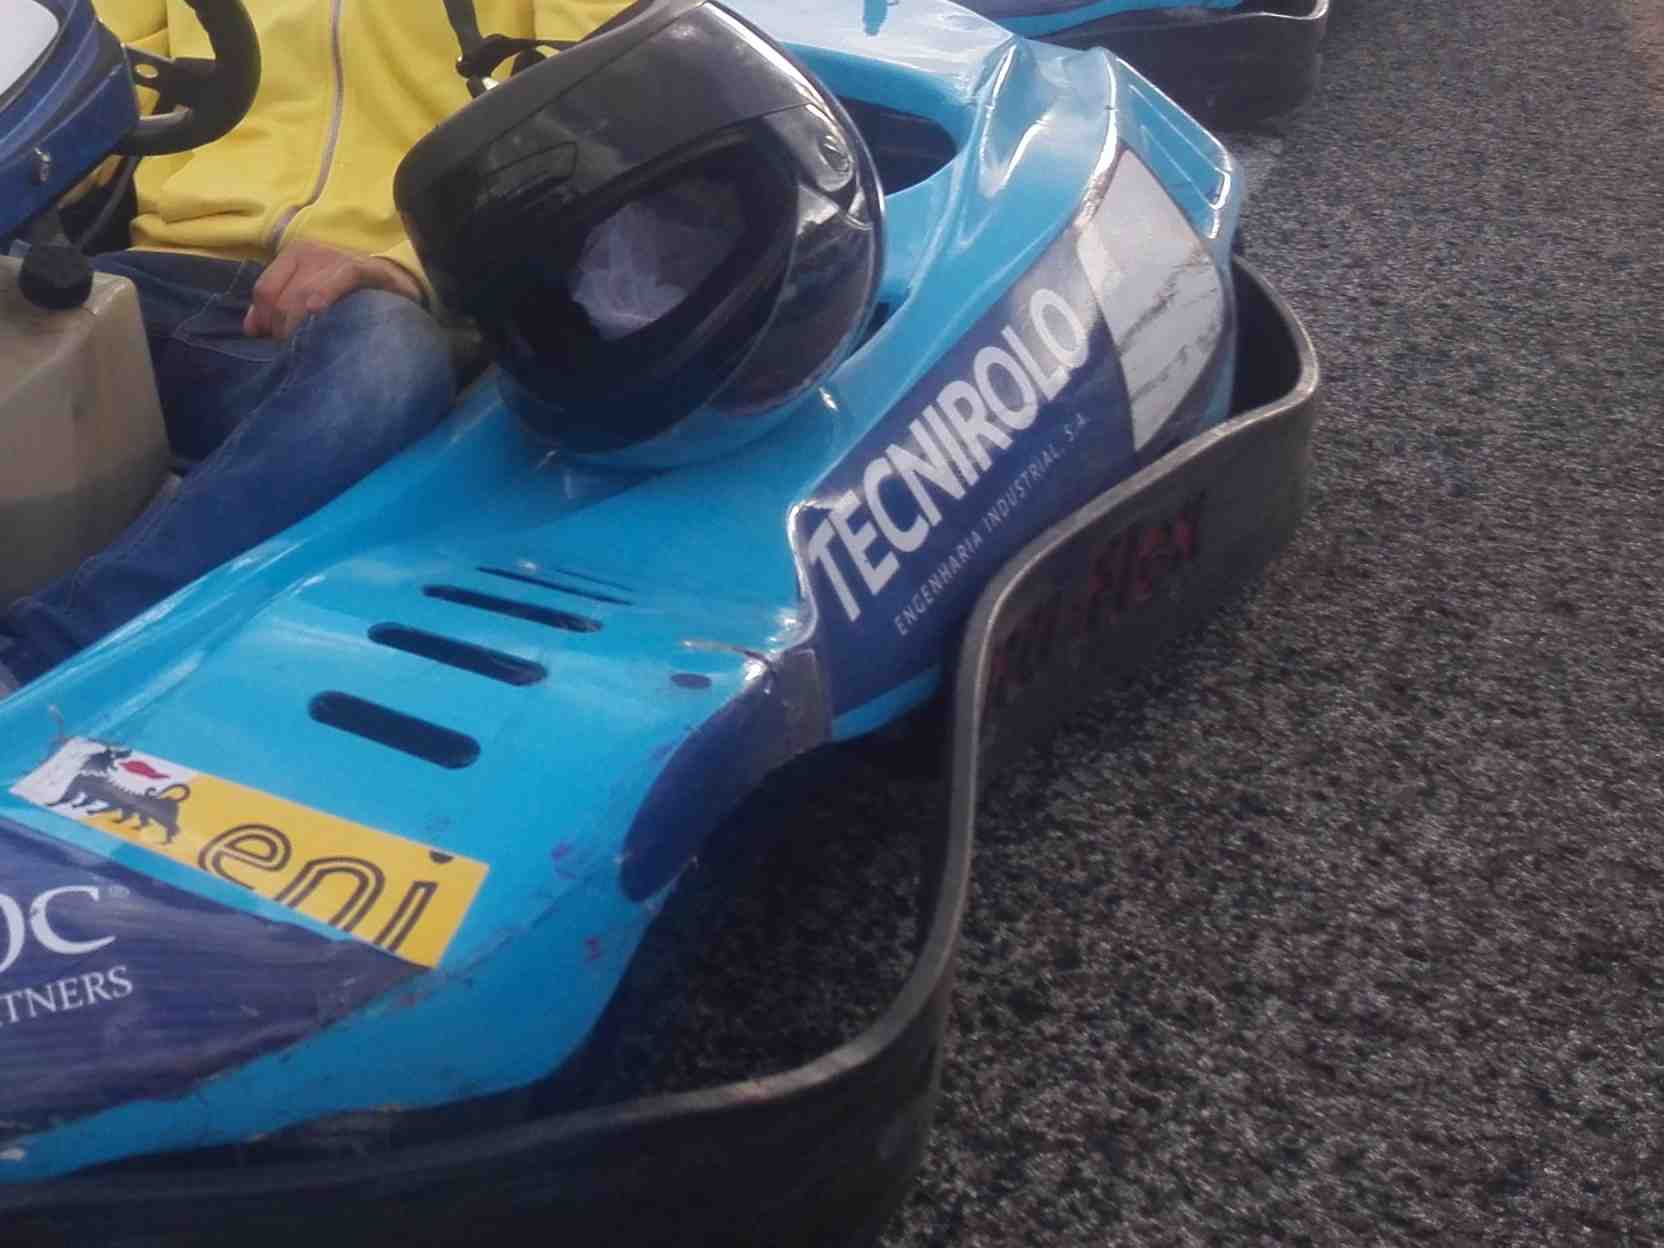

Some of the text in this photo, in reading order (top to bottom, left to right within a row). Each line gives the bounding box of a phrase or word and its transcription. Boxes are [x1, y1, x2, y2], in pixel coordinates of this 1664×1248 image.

[806, 288, 1089, 622] TECNIROLO
[892, 530, 984, 637] ENGENHARIA
[197, 819, 454, 953] eni
